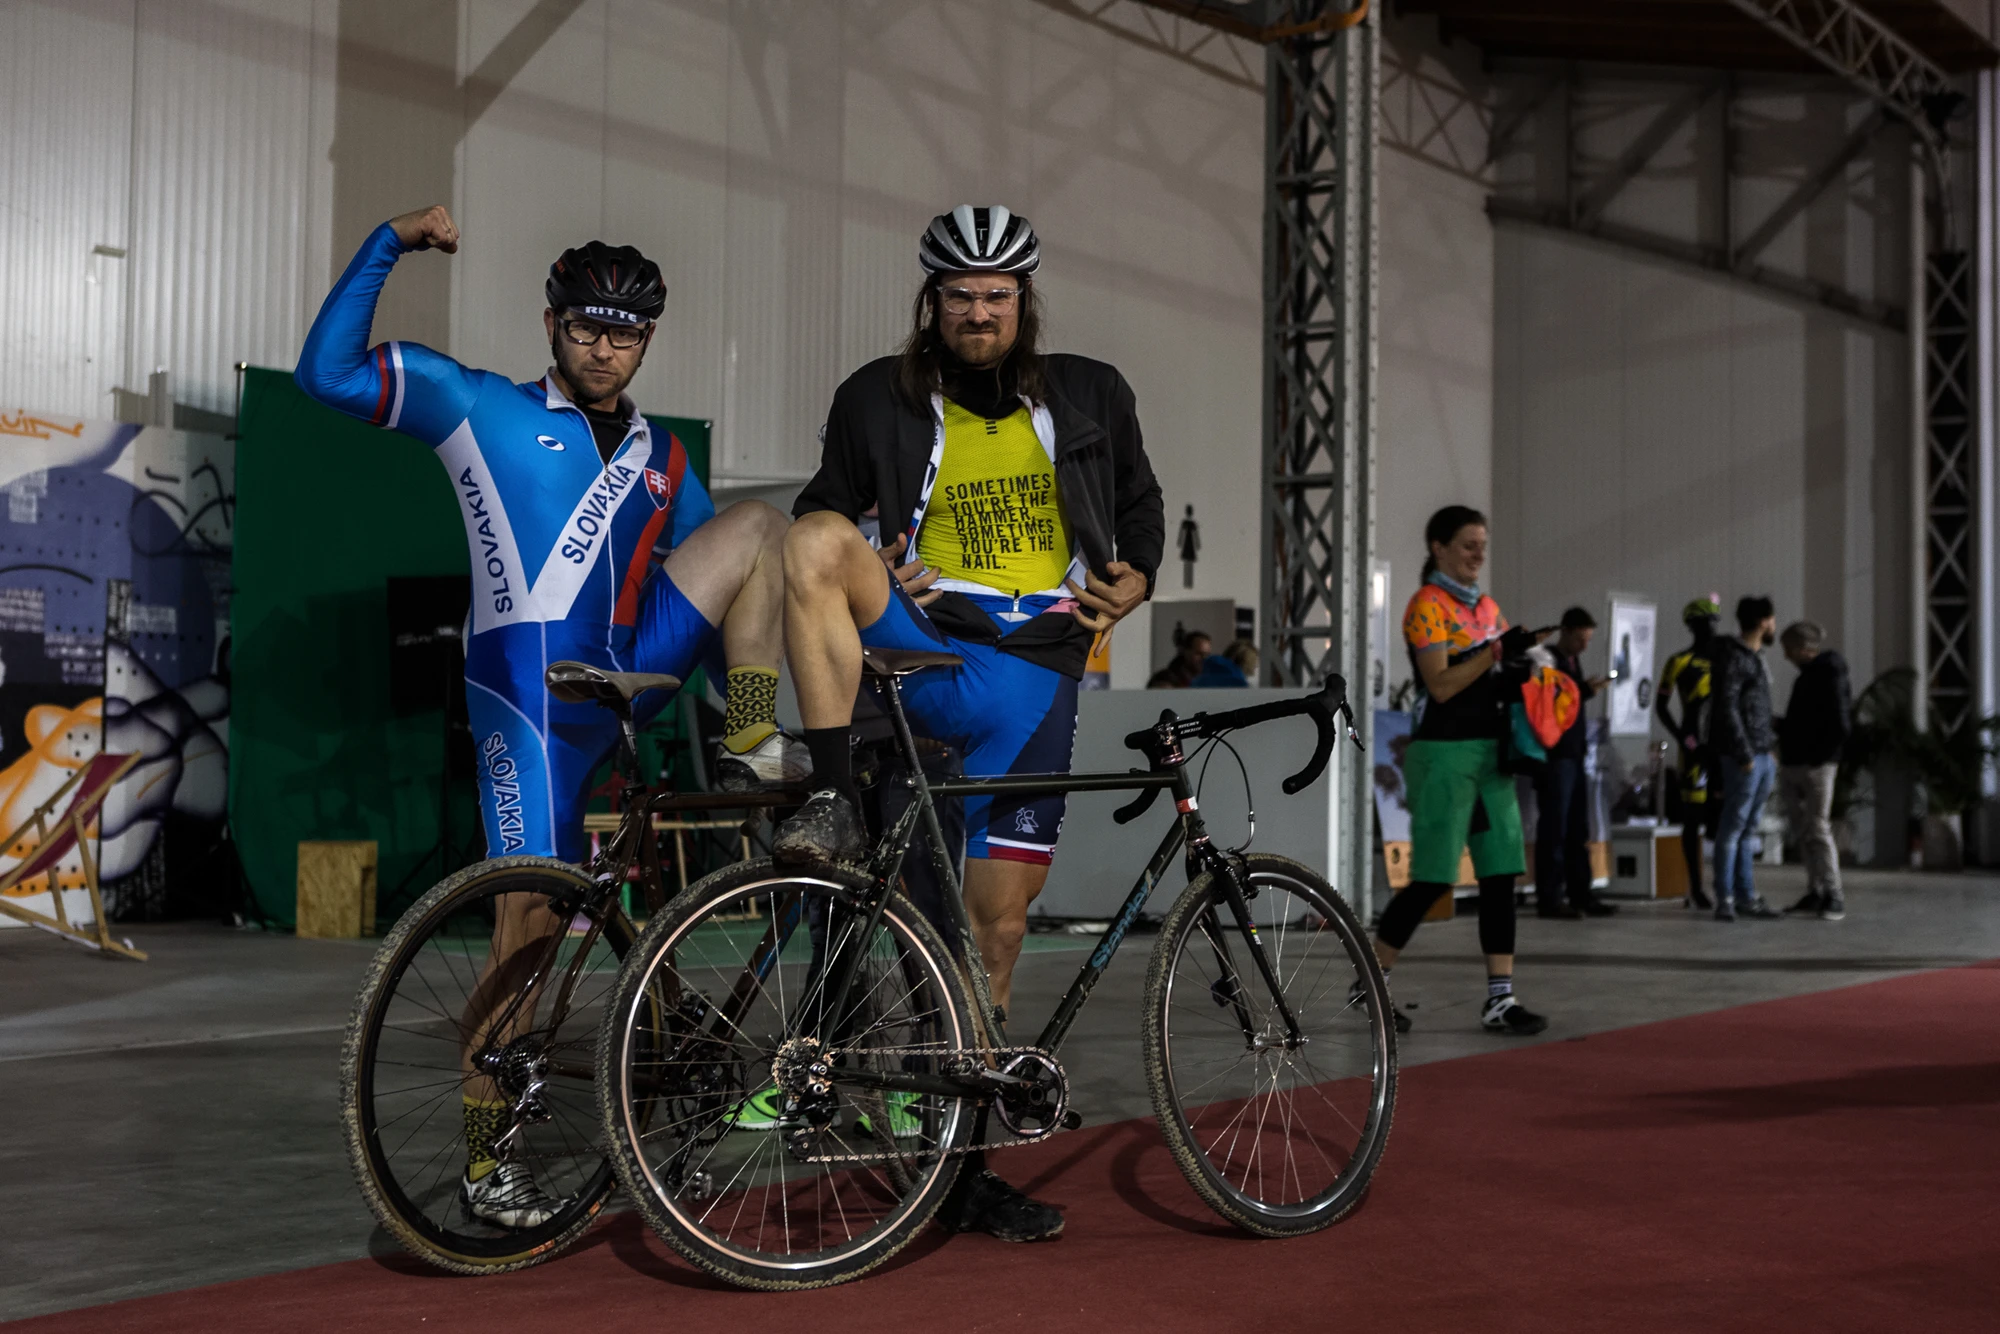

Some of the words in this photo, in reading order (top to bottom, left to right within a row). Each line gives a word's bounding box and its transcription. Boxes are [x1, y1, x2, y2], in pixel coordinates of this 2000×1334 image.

[585, 306, 637, 322] RITTE
[945, 473, 1051, 501] SOMETIMES
[561, 464, 636, 564] SLOVAKIA
[948, 494, 1013, 517] YOU'RE
[1018, 490, 1049, 509] THE
[955, 507, 1035, 529] HAMMER,
[957, 519, 1054, 541] SOMETIMES
[459, 466, 512, 613] SLOVAKIA
[960, 537, 1022, 554] YOU'RE
[1028, 535, 1054, 551] THE
[962, 554, 1006, 569] NAIL.
[483, 731, 525, 854] SLOVAKIA
